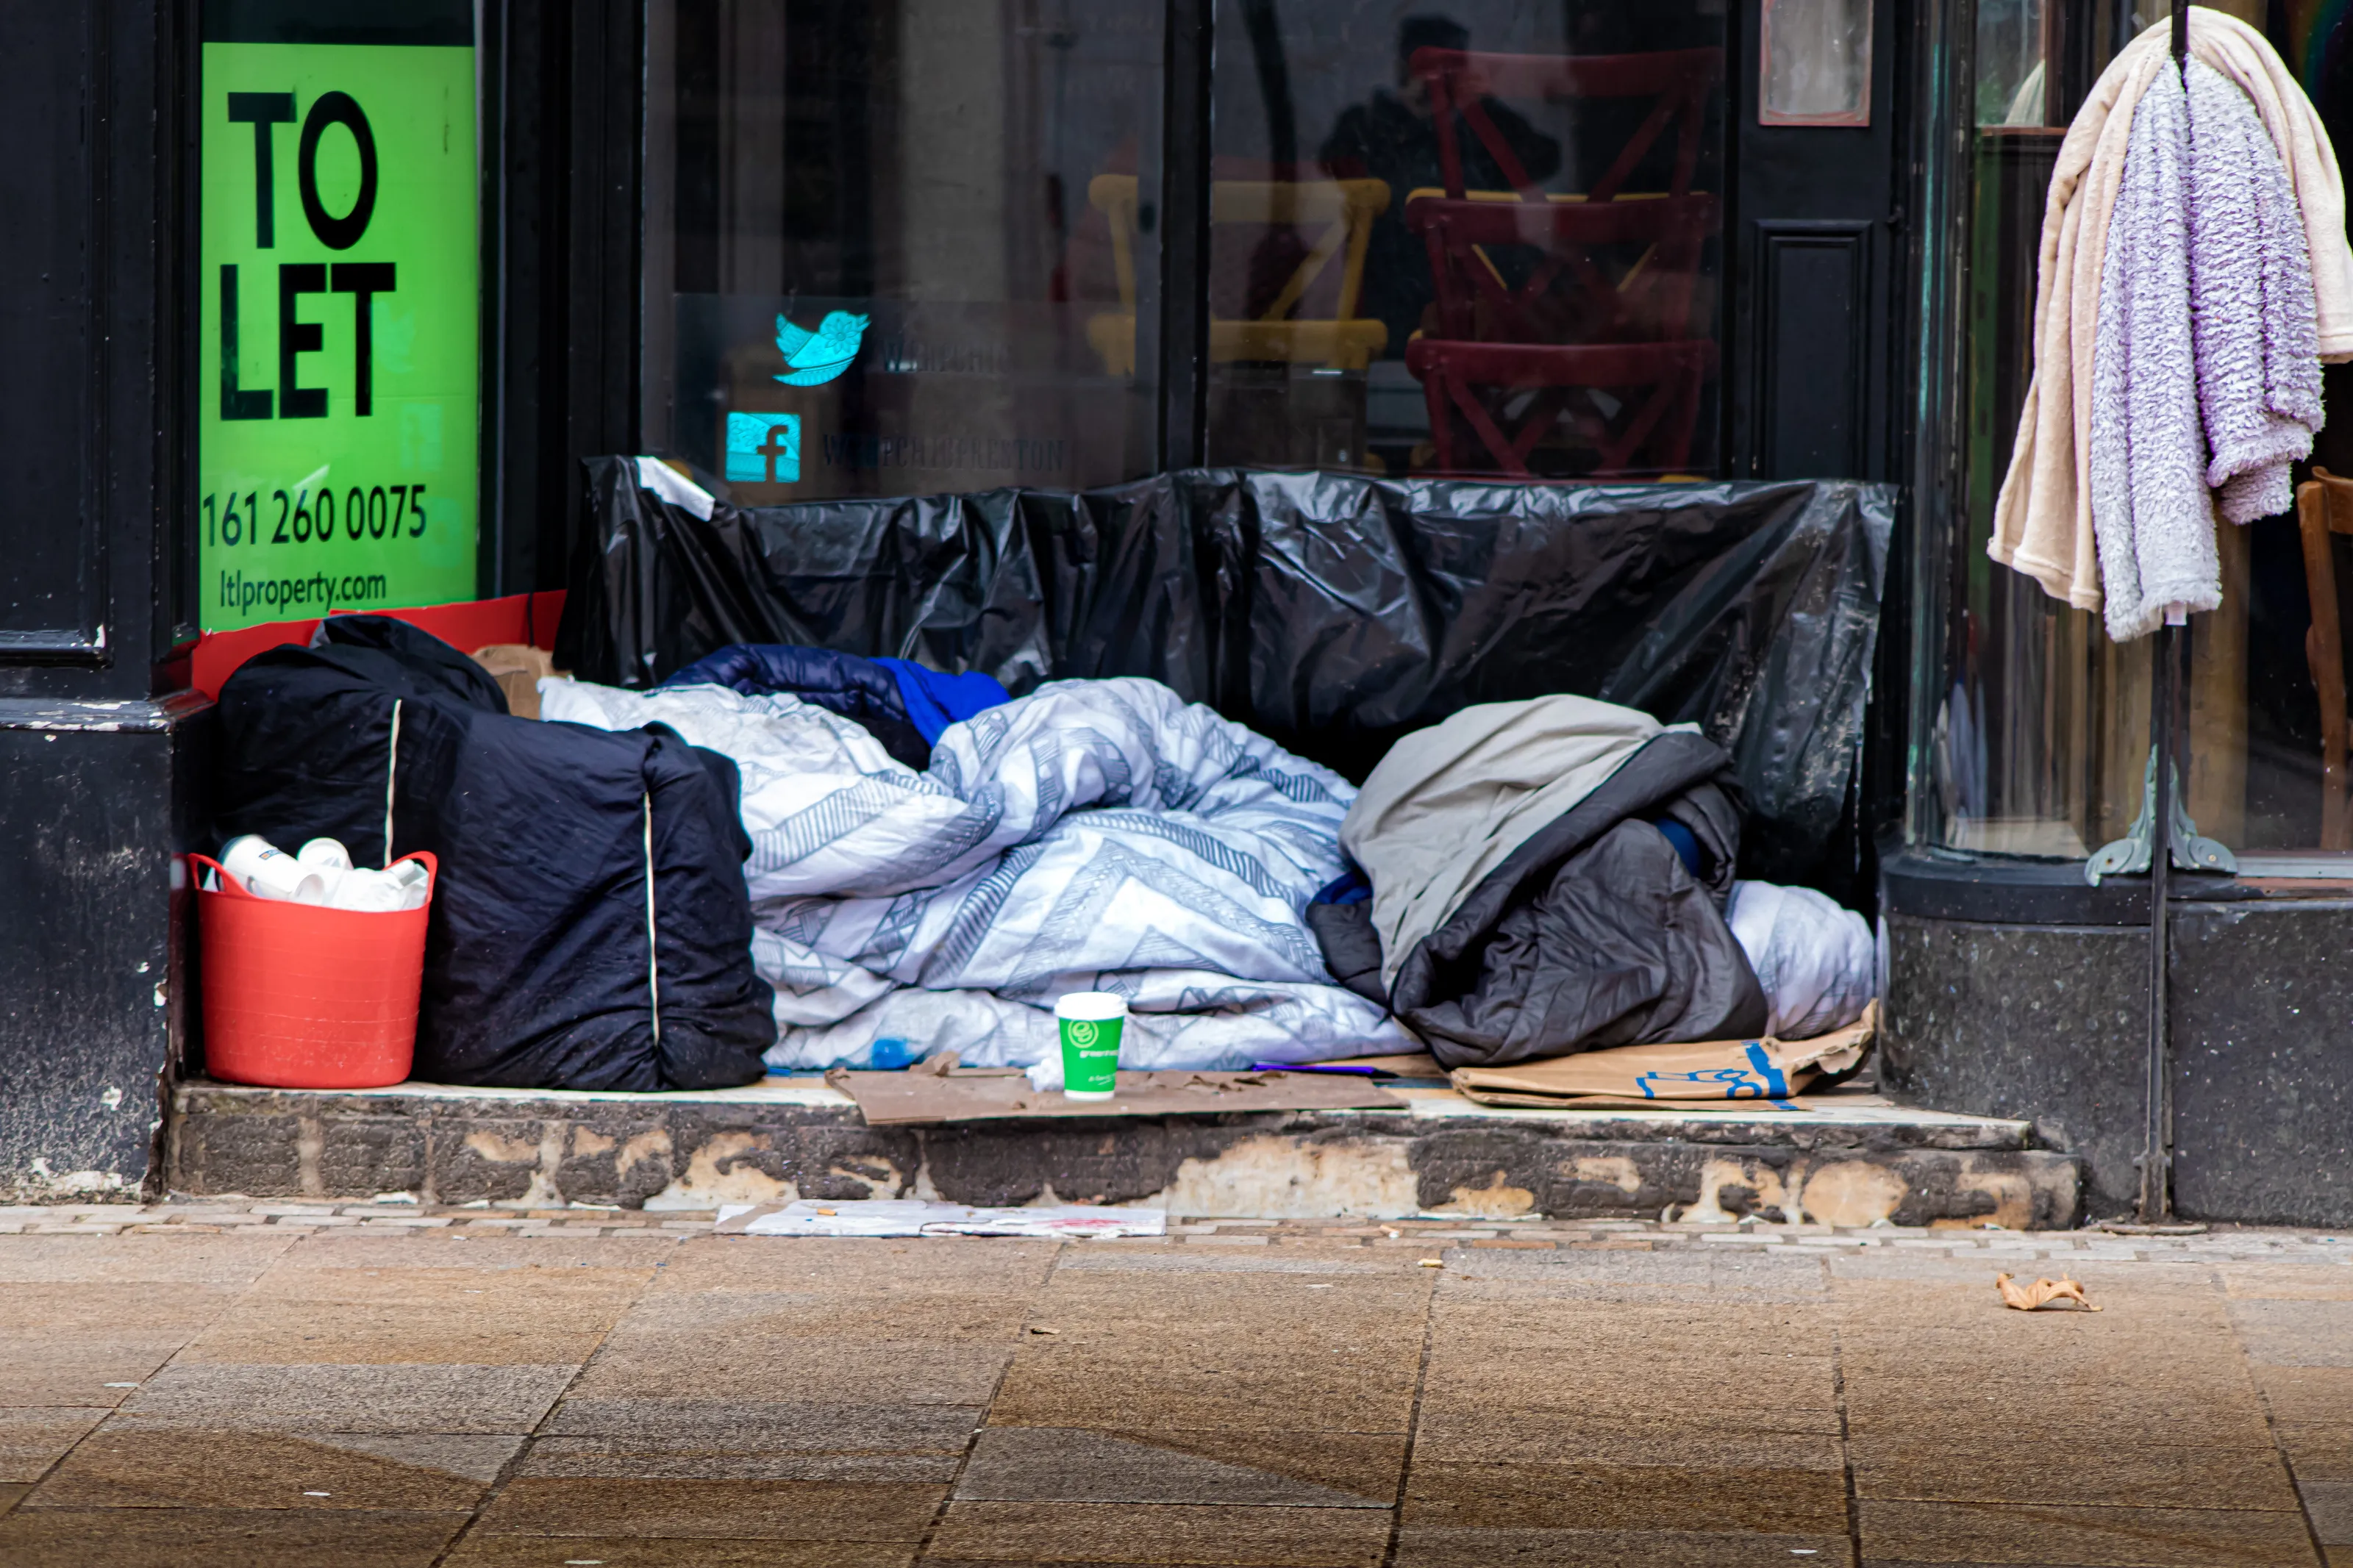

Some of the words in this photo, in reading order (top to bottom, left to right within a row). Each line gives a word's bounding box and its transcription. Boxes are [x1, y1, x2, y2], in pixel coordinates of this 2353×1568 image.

[226, 90, 378, 251] TO
[219, 262, 397, 420] LET
[823, 434, 1065, 471] WPCHICPRESTON
[203, 491, 257, 547] 161
[271, 487, 335, 544] 260
[346, 484, 427, 541] 0075
[220, 569, 387, 617] ltlproperty.com
